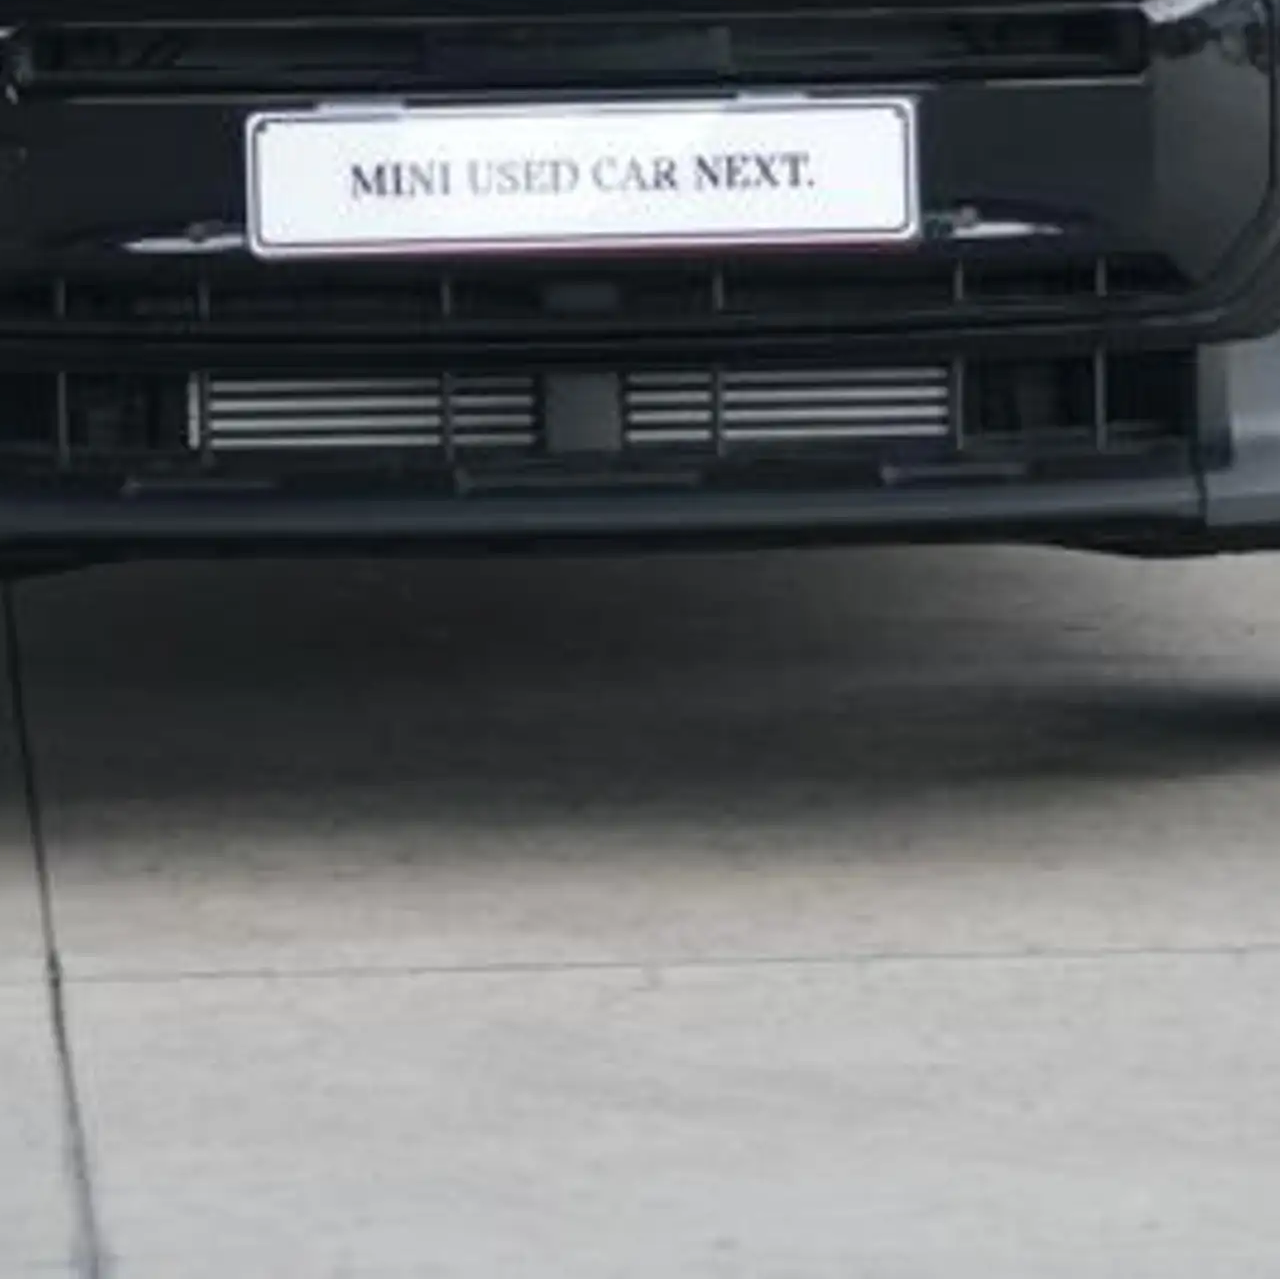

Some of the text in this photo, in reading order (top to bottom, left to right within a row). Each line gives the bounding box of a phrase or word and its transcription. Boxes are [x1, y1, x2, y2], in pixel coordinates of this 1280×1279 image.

[350, 147, 816, 198] MINI USED CAR NEXT.
